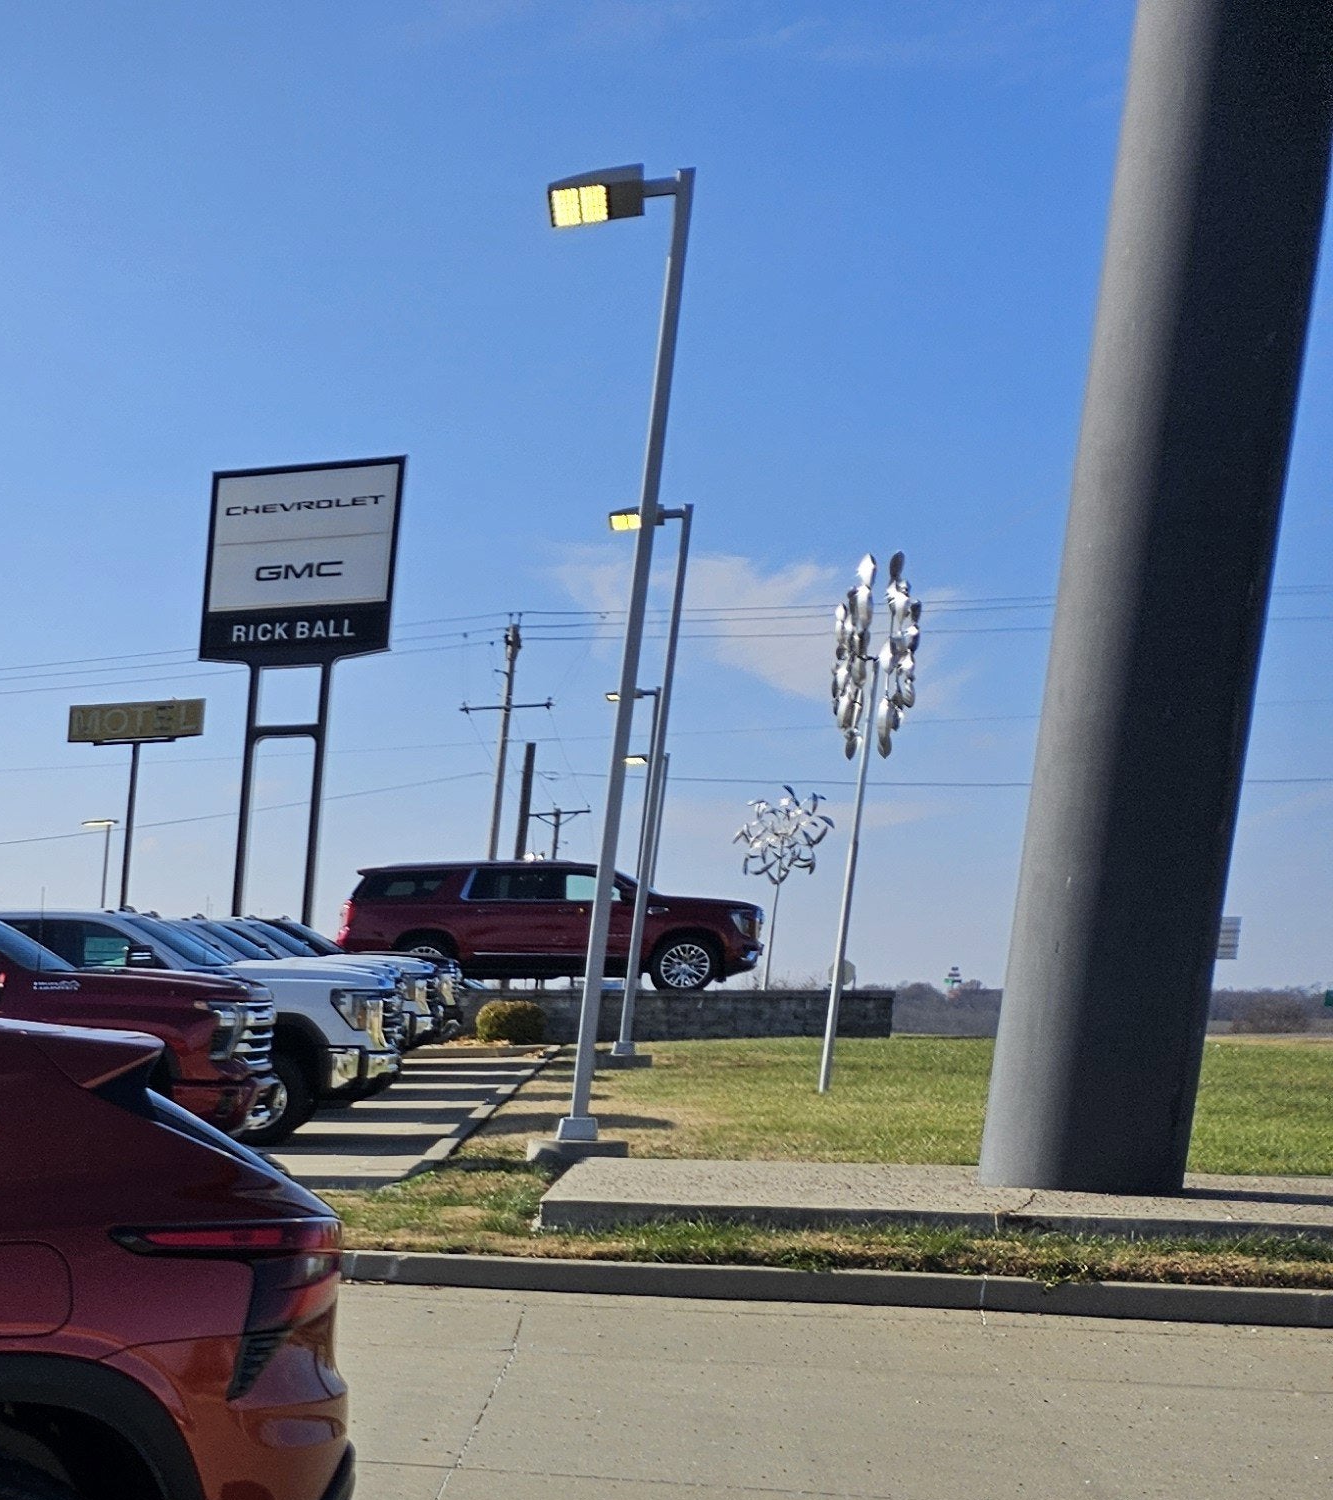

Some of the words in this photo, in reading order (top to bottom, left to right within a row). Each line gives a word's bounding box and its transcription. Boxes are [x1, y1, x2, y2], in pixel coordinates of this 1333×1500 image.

[226, 495, 385, 516] CHEVROLET
[255, 561, 343, 582] GMC
[233, 622, 289, 642] RICK
[296, 618, 355, 639] BALL
[75, 704, 198, 736] MOTEL
